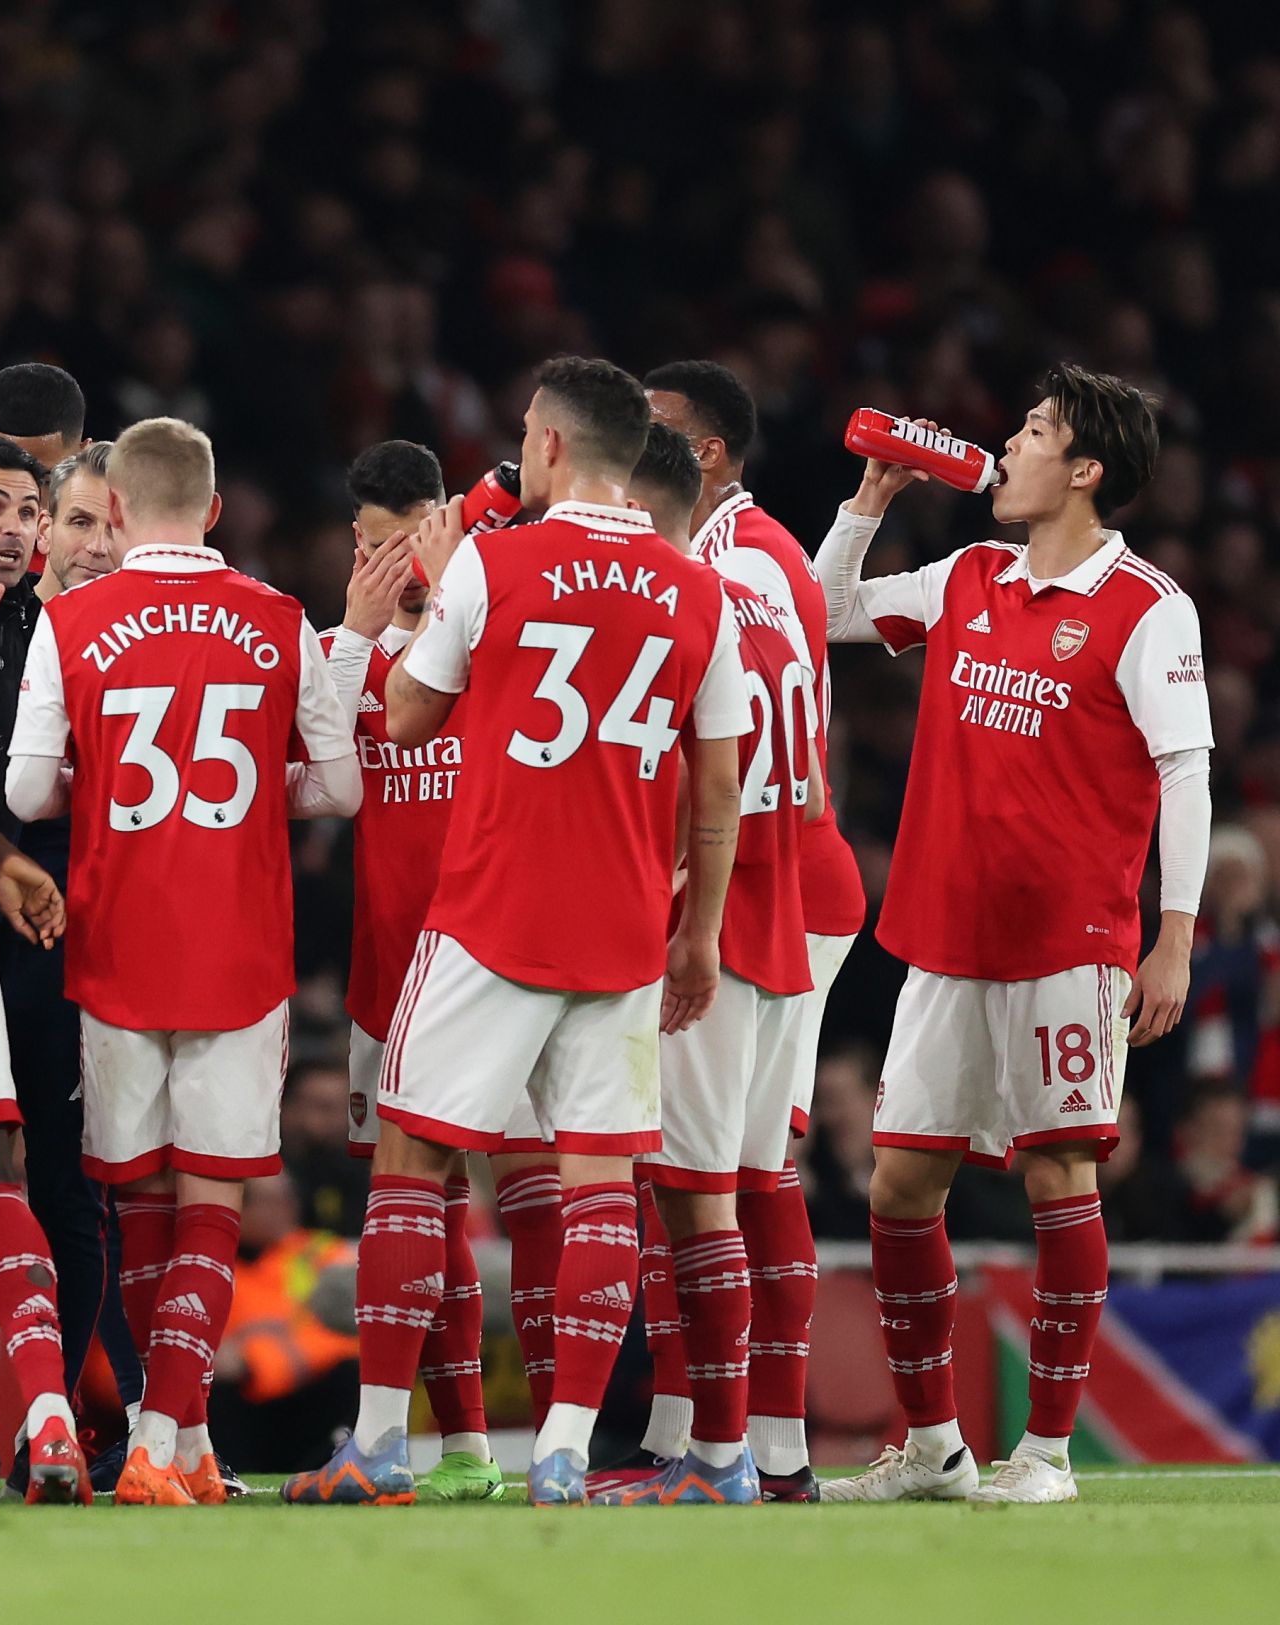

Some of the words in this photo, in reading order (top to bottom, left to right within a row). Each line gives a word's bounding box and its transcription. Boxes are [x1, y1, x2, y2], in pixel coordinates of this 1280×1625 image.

[585, 532, 629, 545] ARSENAL
[541, 559, 679, 617] XHAKA
[81, 603, 280, 672] ZINCHENKO
[506, 621, 681, 780] 34
[950, 650, 1072, 710] Emirates
[740, 660, 810, 818] 20
[959, 694, 987, 726] FLY
[983, 700, 1043, 739] BETTER
[101, 682, 267, 833] 35
[358, 735, 466, 769] Emira
[382, 773, 412, 804] FLY
[418, 770, 462, 802] BET
[1034, 1023, 1096, 1087] 18
[1059, 1103, 1093, 1113] adidas
[521, 1313, 552, 1330] AF
[1030, 1316, 1078, 1334] AFC
